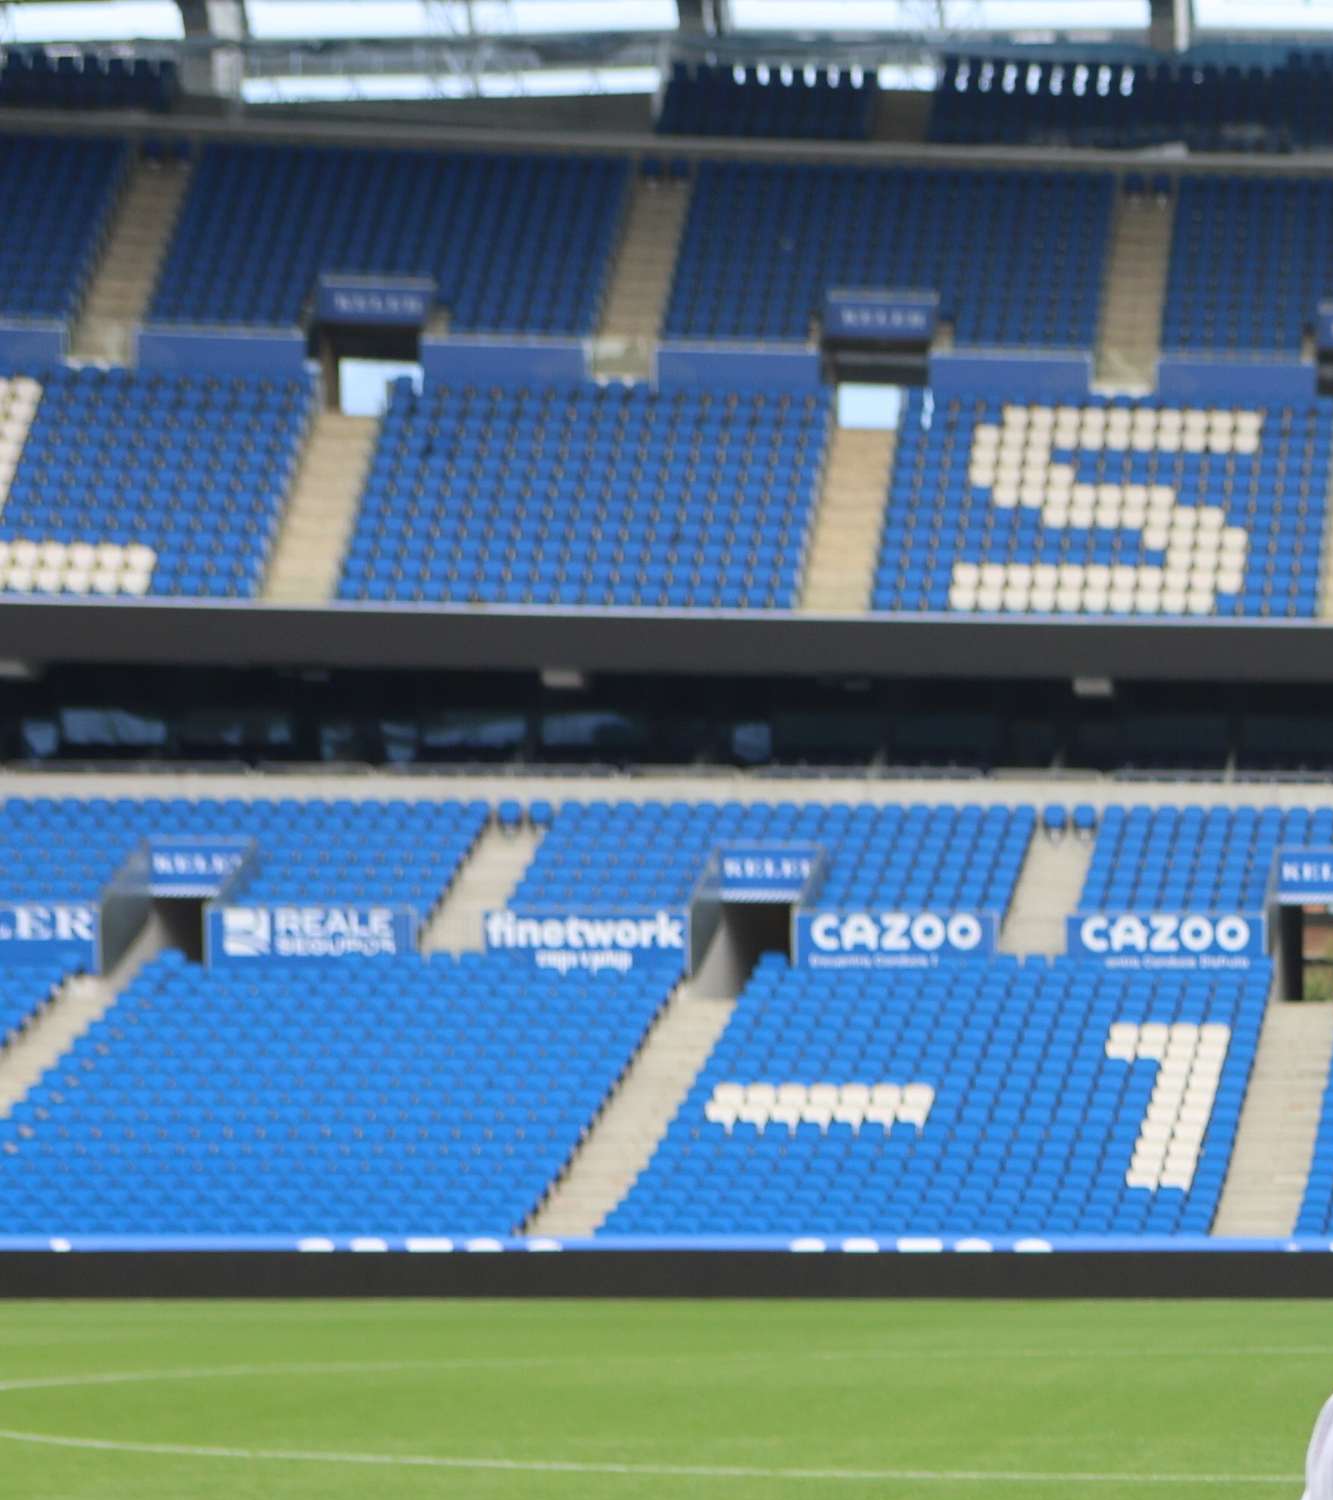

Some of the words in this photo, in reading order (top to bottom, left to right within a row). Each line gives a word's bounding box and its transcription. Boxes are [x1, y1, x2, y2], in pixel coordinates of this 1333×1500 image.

[0, 906, 95, 941] ER
[274, 907, 395, 936] REALE
[486, 911, 684, 949] finetwork
[810, 913, 982, 951] CAZOO
[1080, 914, 1250, 952] CAZOO
